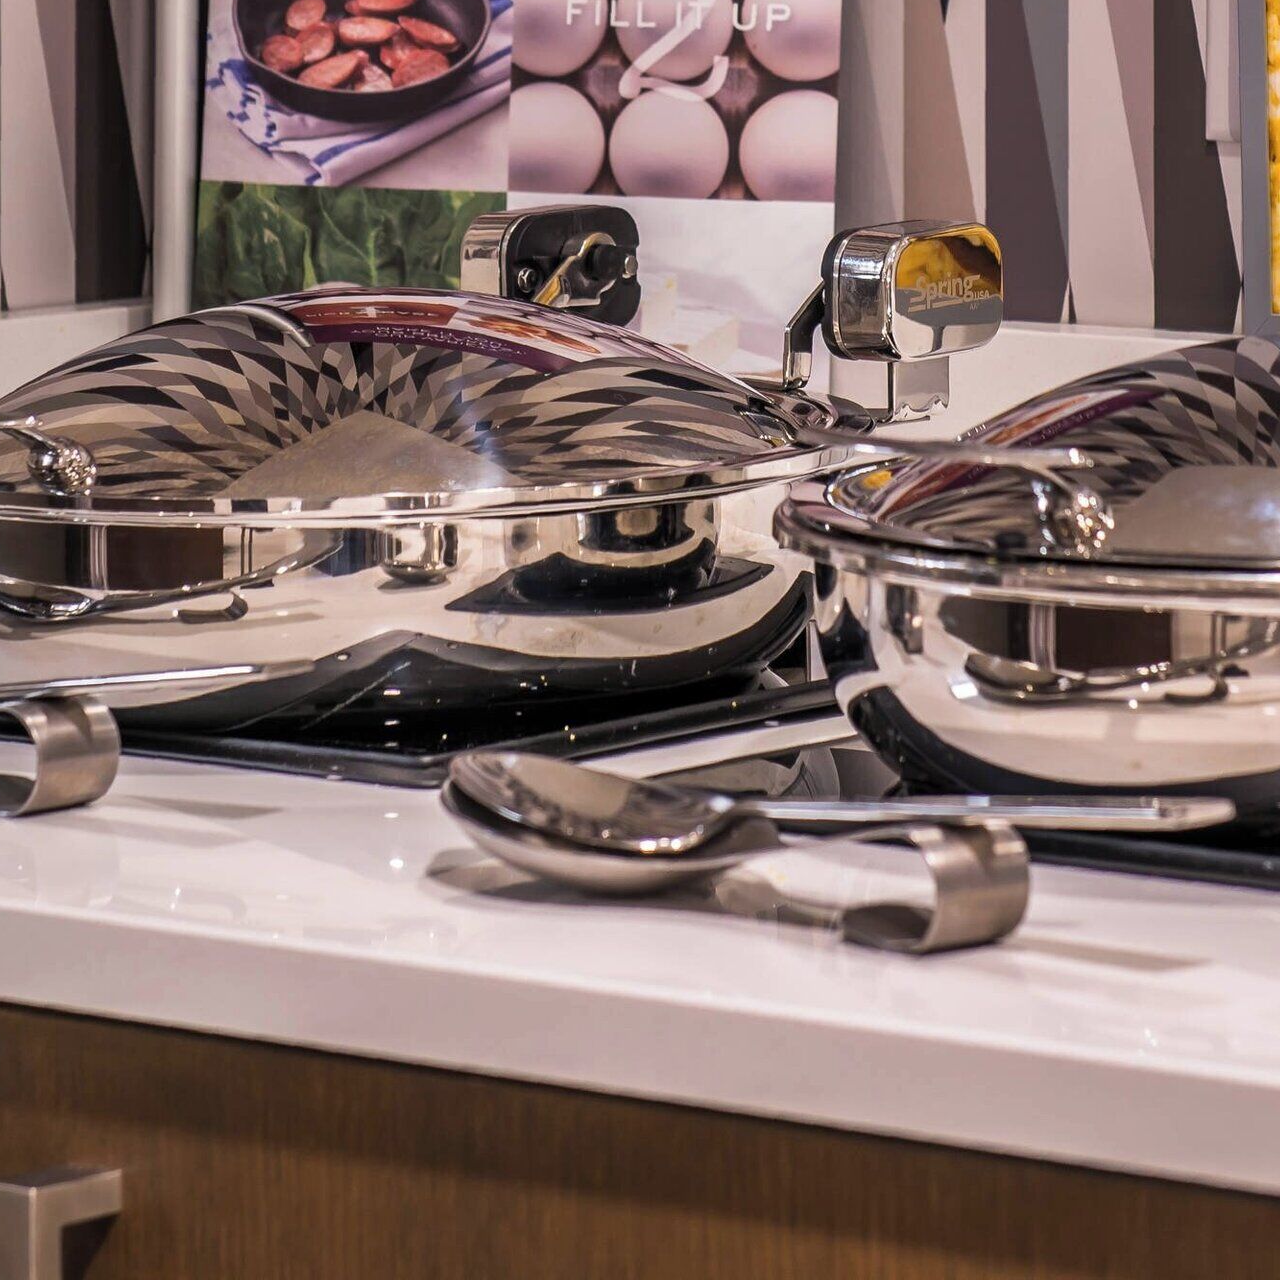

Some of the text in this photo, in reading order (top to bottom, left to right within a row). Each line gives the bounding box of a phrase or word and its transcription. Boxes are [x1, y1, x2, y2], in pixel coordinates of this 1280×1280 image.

[674, 0, 706, 31] IT
[732, 3, 792, 32] UP
[909, 272, 981, 310] Spring
